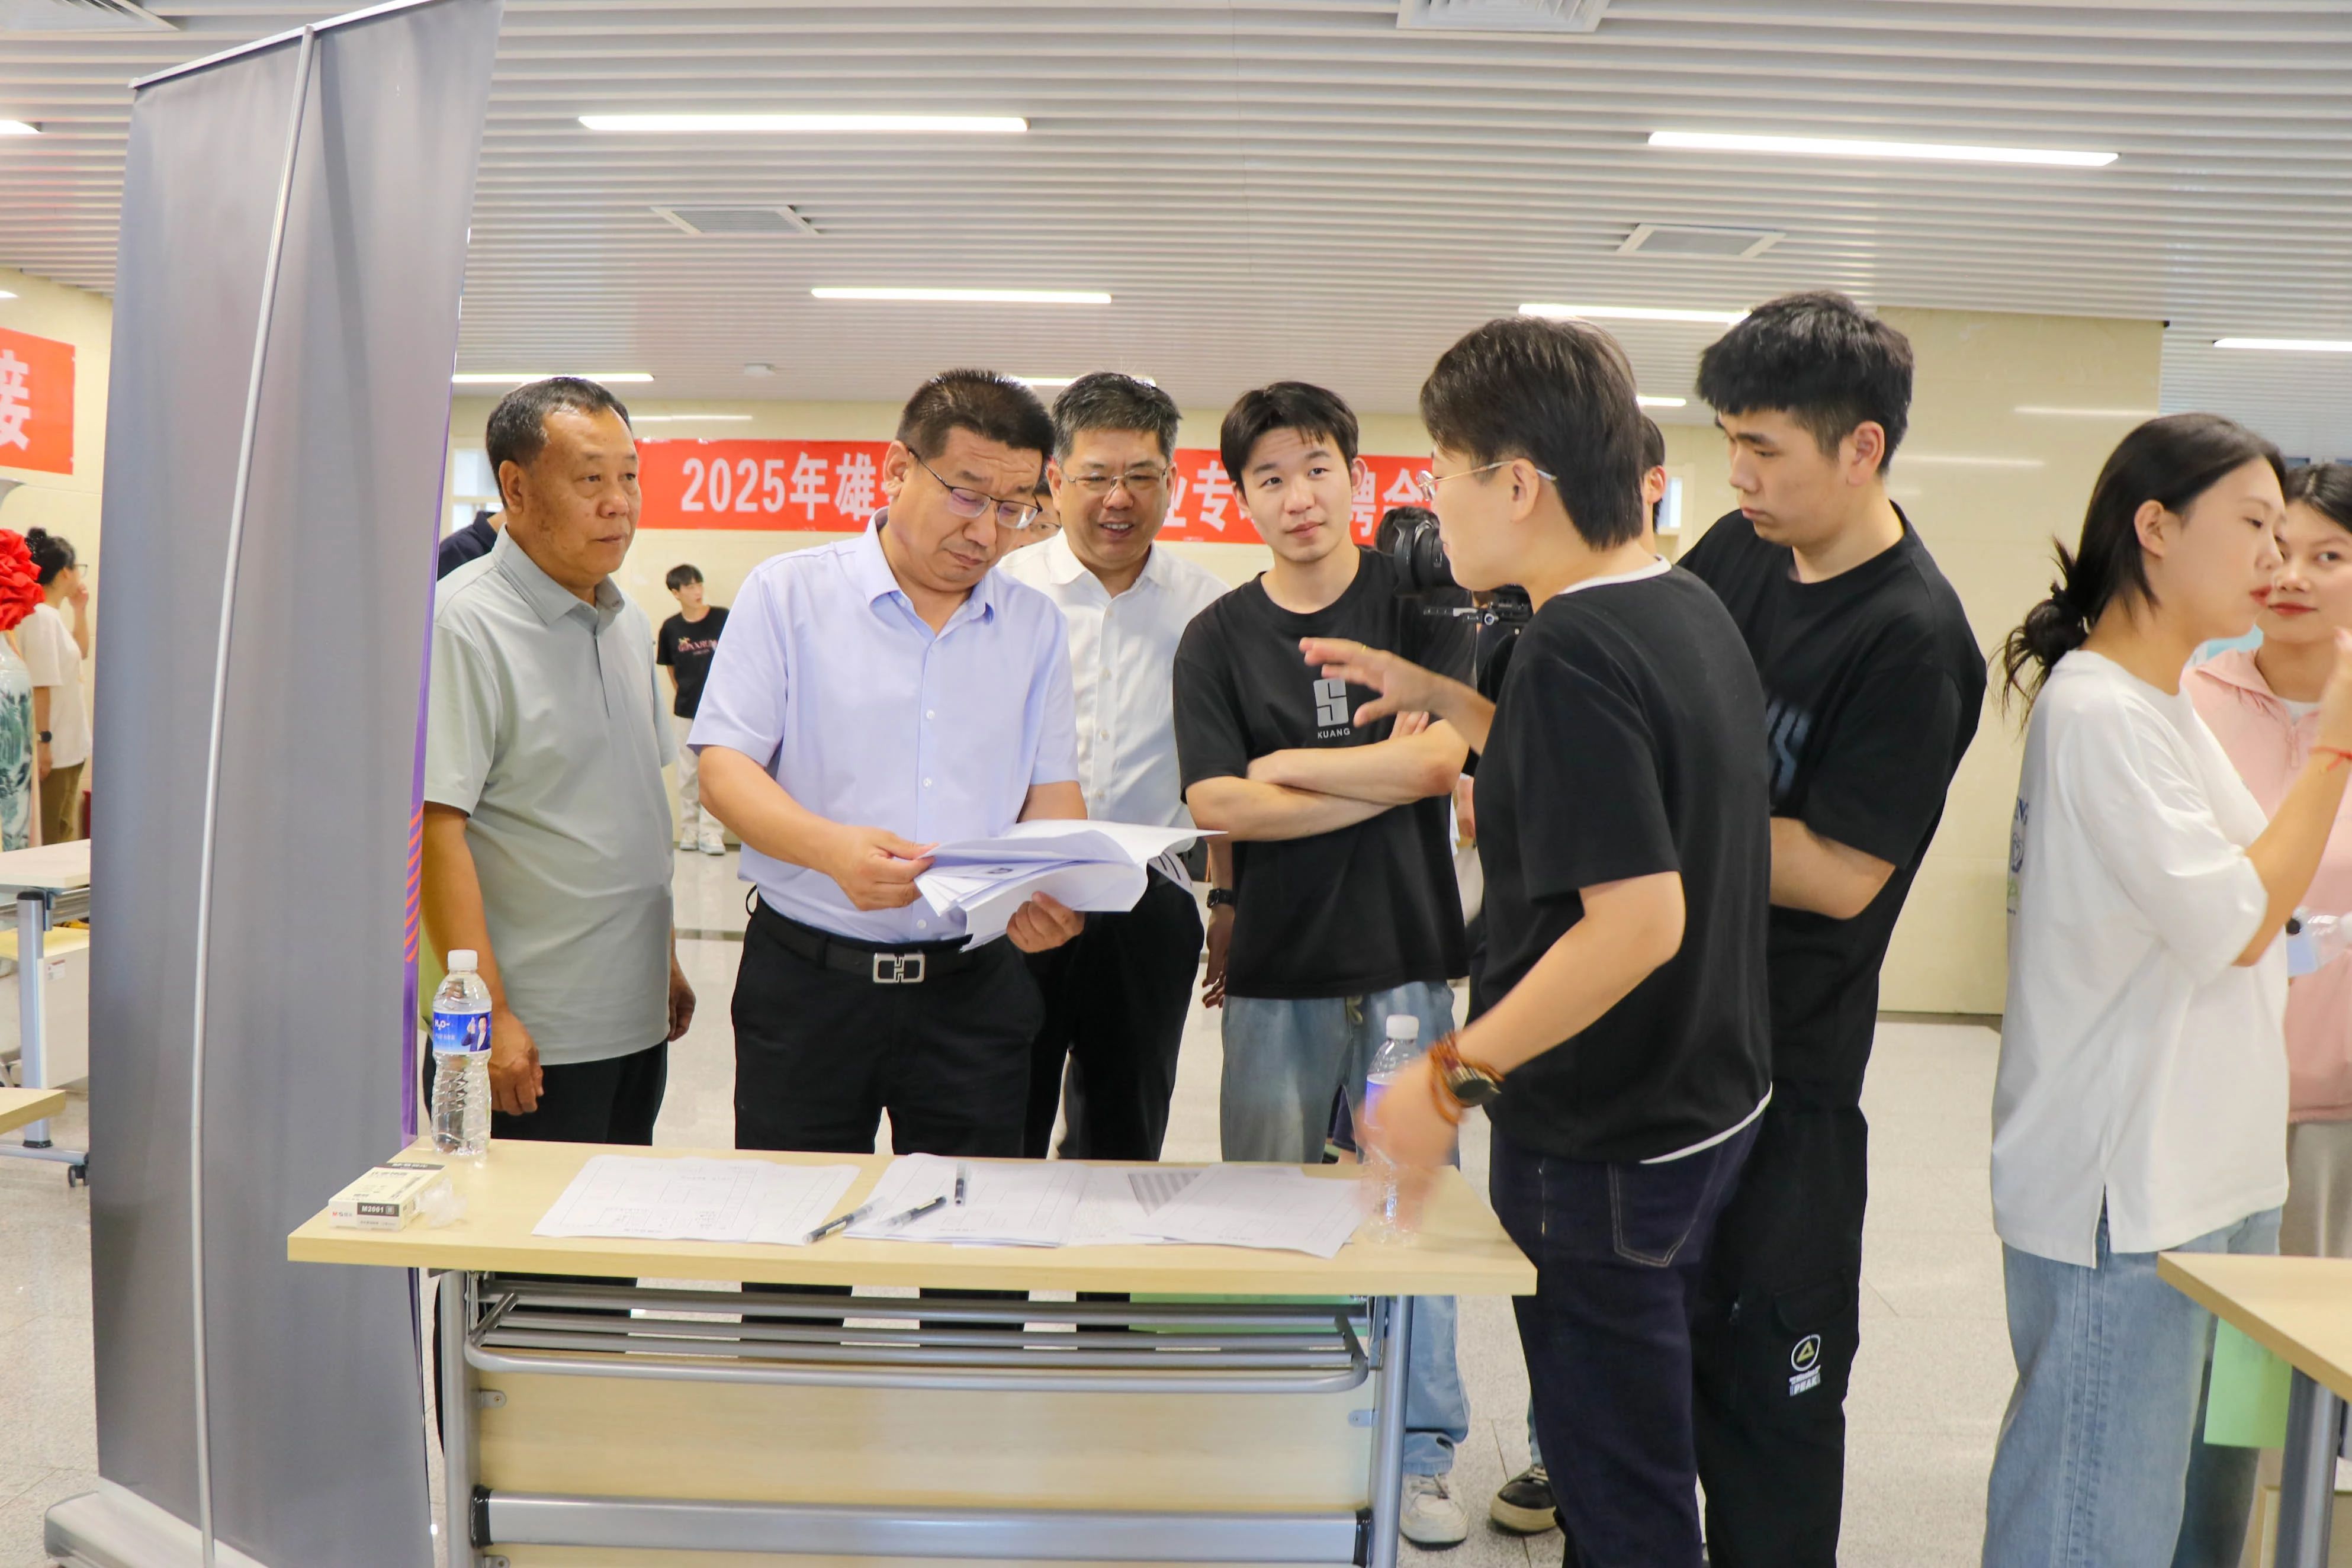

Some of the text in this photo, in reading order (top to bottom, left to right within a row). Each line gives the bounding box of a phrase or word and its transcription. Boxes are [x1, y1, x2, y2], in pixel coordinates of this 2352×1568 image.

[681, 452, 888, 522] 2025年雄
[1317, 727, 1351, 740] KUANG
[361, 1205, 384, 1213] M2001
